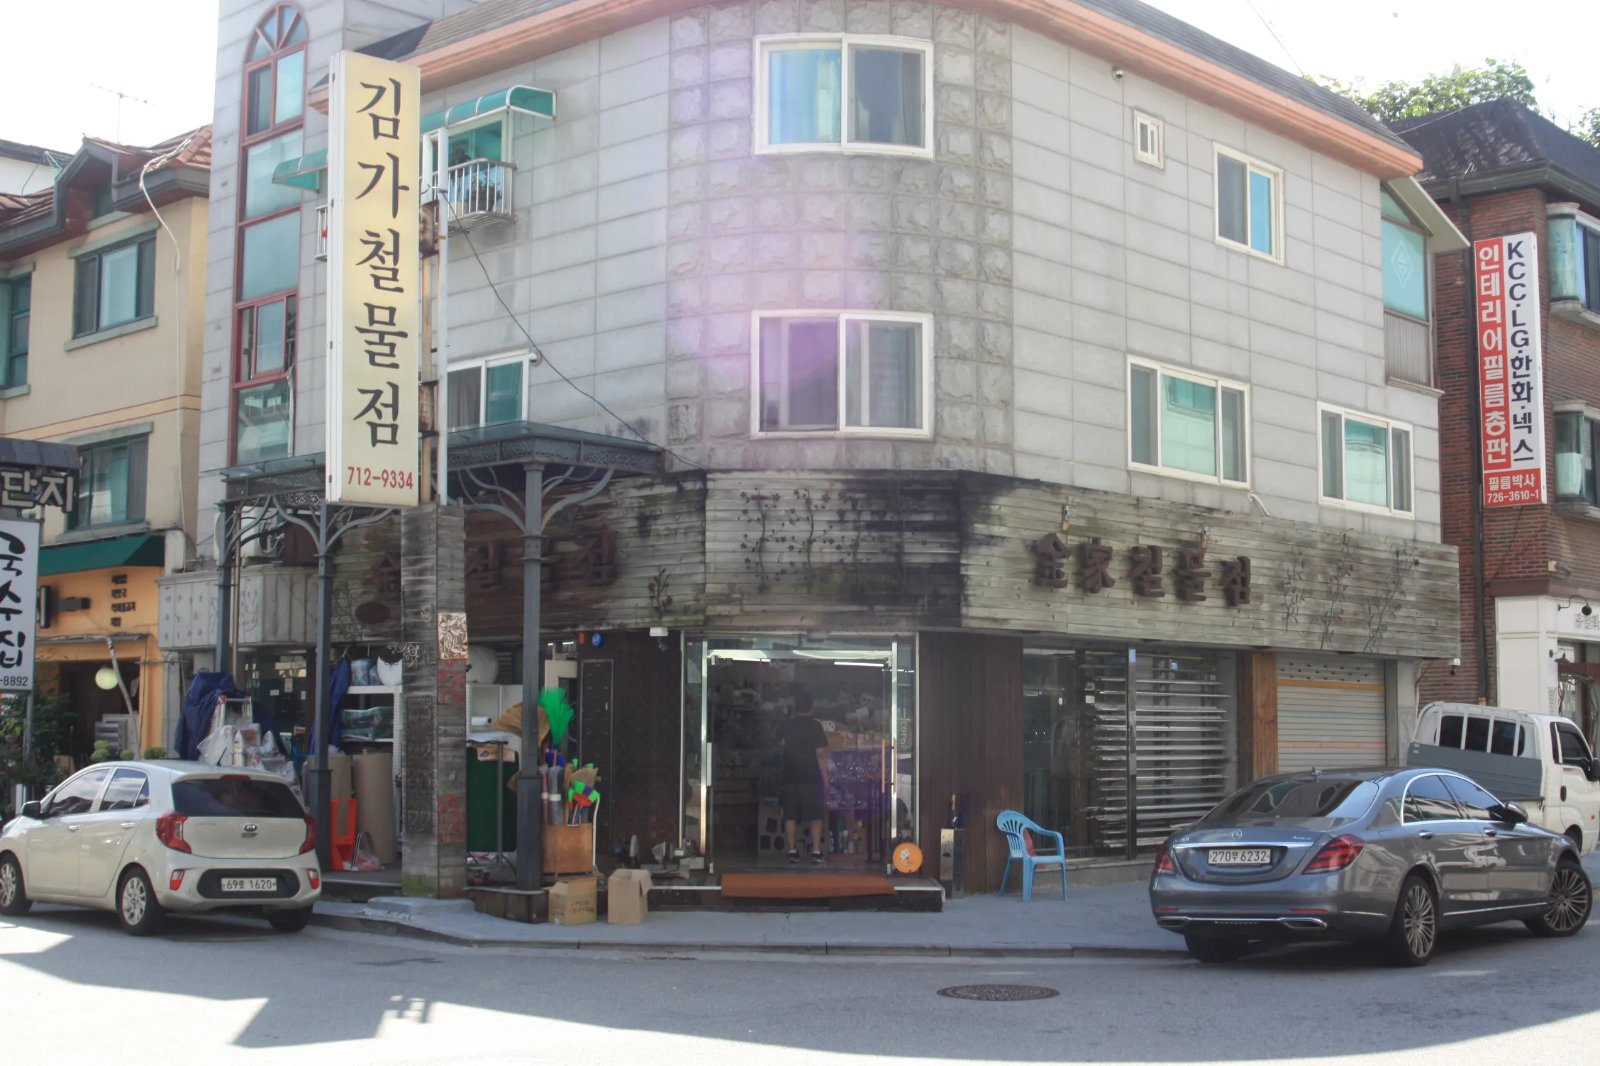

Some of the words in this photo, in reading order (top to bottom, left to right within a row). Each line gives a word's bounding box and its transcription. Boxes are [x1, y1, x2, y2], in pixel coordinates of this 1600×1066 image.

[353, 76, 410, 449] 김가철물점
[347, 466, 413, 489] 712-9334
[1488, 473, 1536, 491] 필름박사
